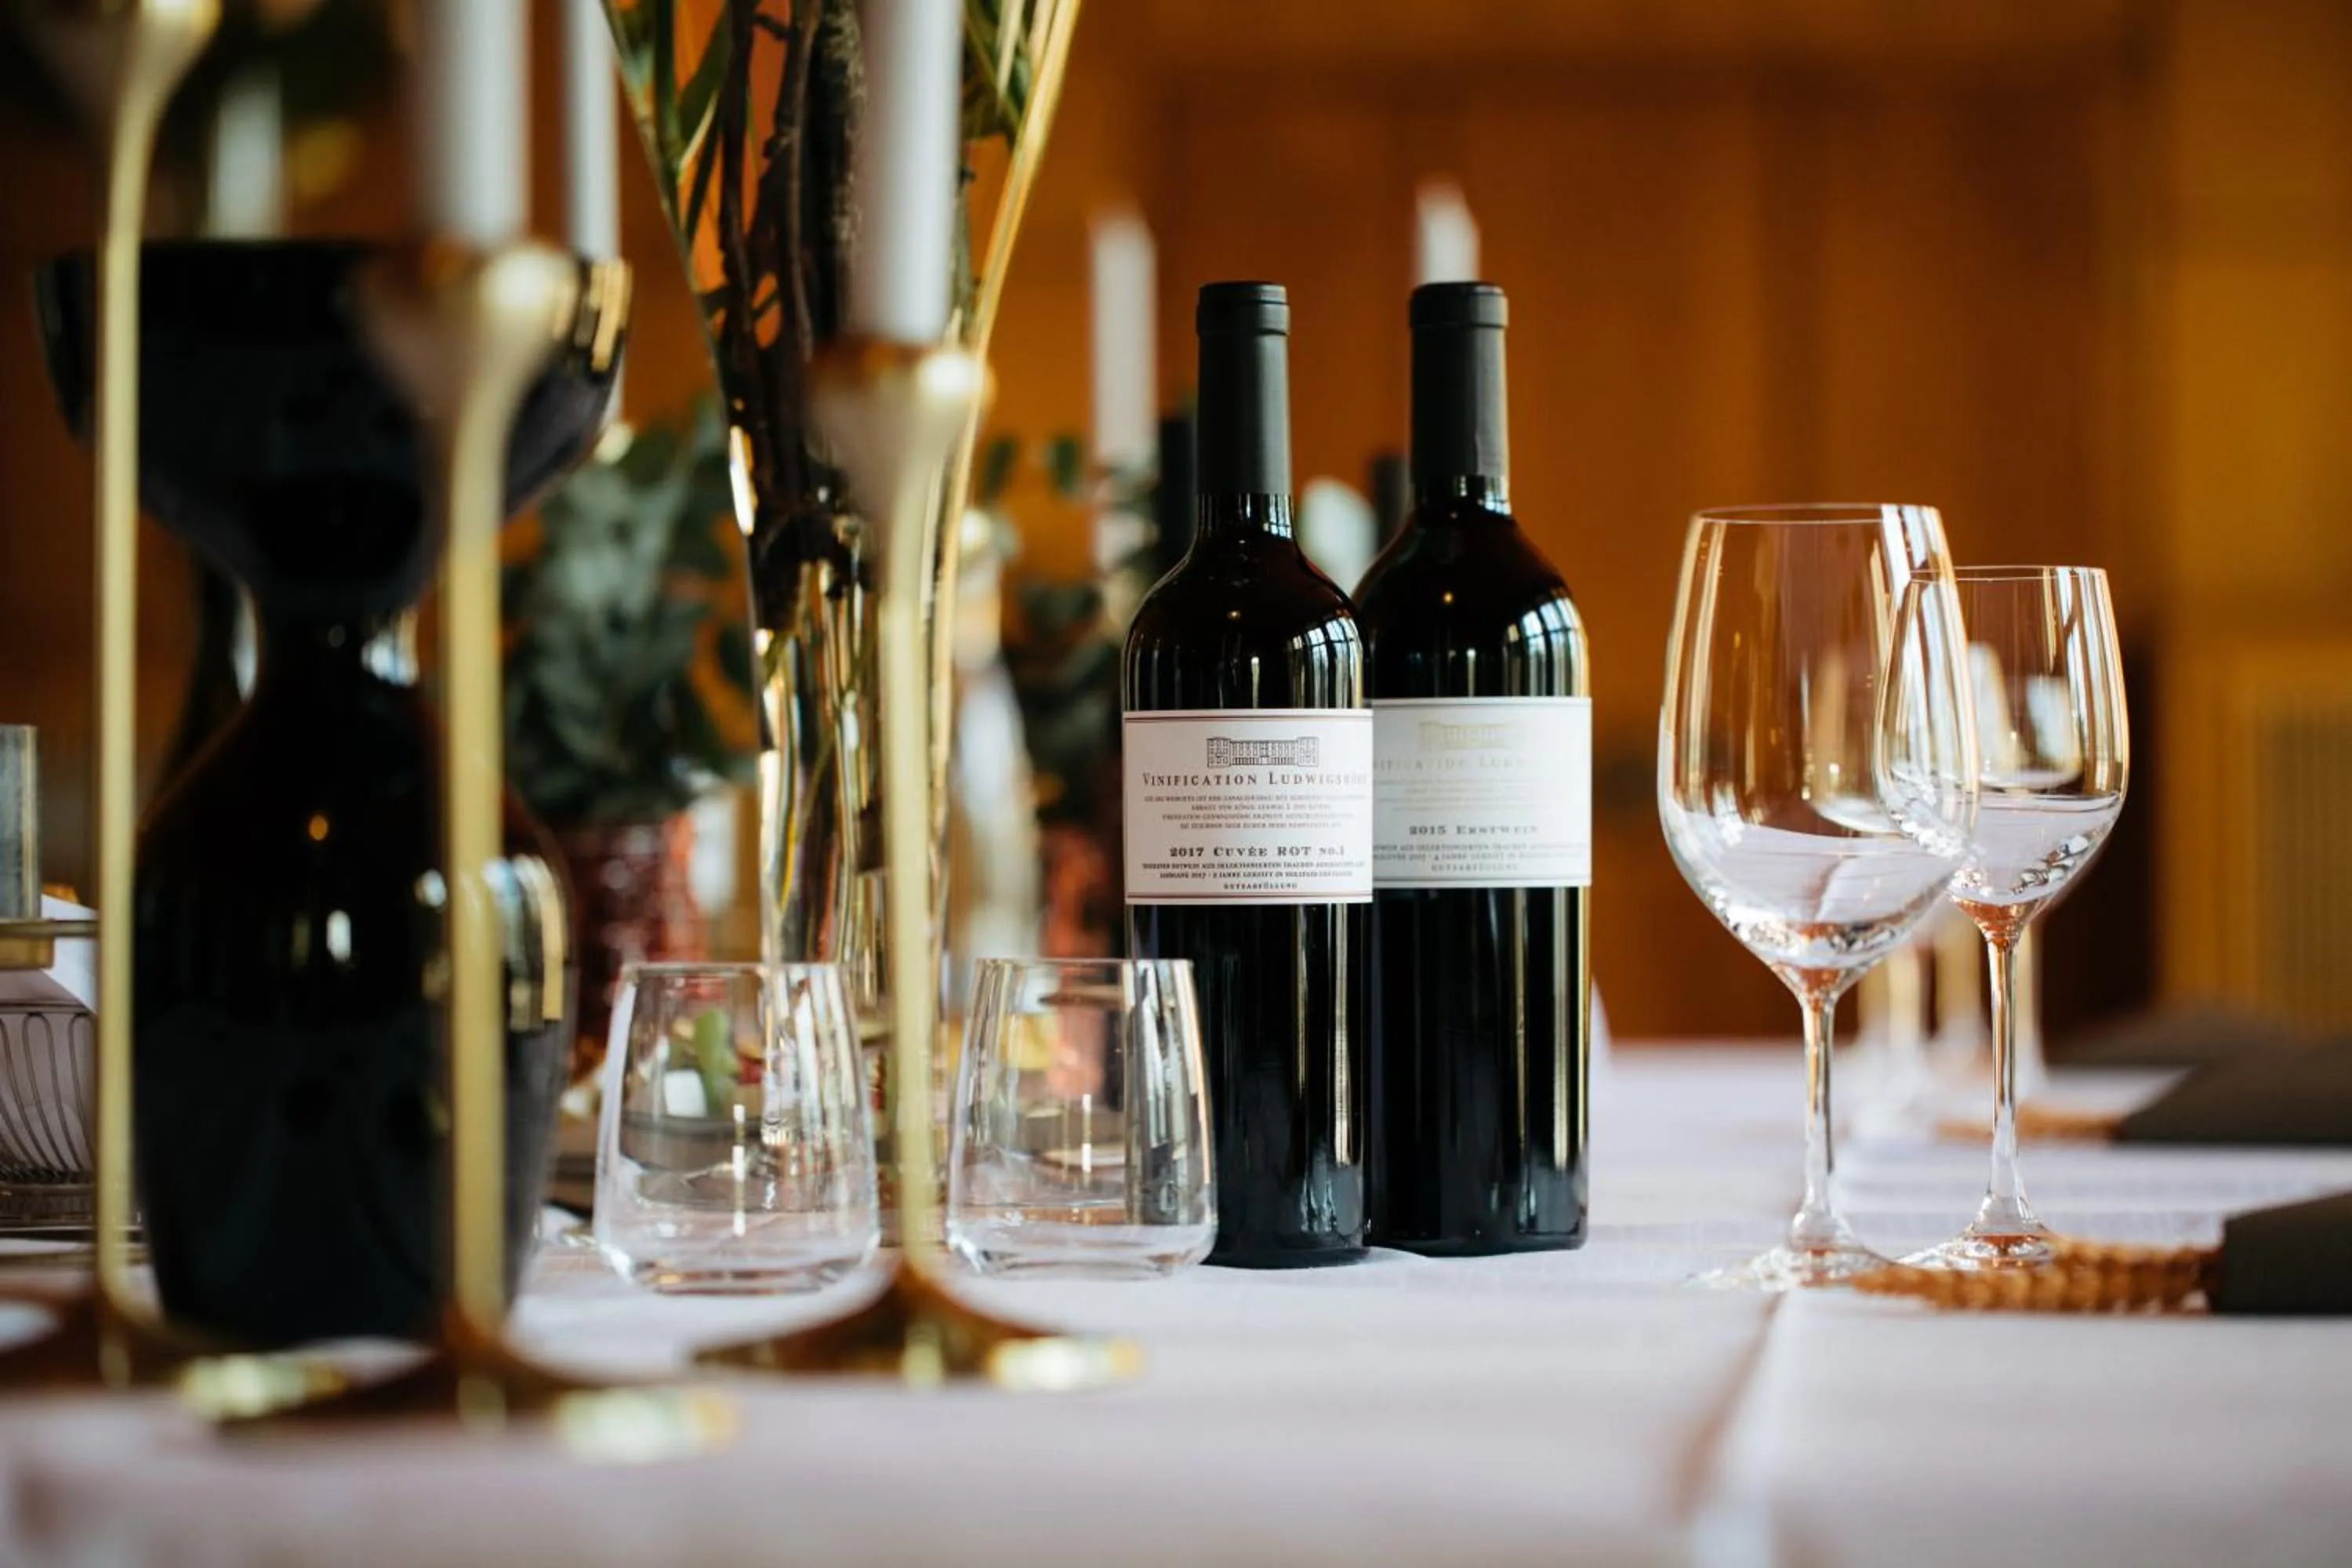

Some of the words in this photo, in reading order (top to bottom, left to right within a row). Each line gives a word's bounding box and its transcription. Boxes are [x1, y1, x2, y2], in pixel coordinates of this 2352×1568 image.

[1142, 771, 1258, 786] VINIFICATION
[1409, 826, 1447, 836] 2015
[1170, 848, 1205, 857] 2017
[1213, 845, 1268, 857] CUVÉE
[1277, 846, 1312, 856] ROT
